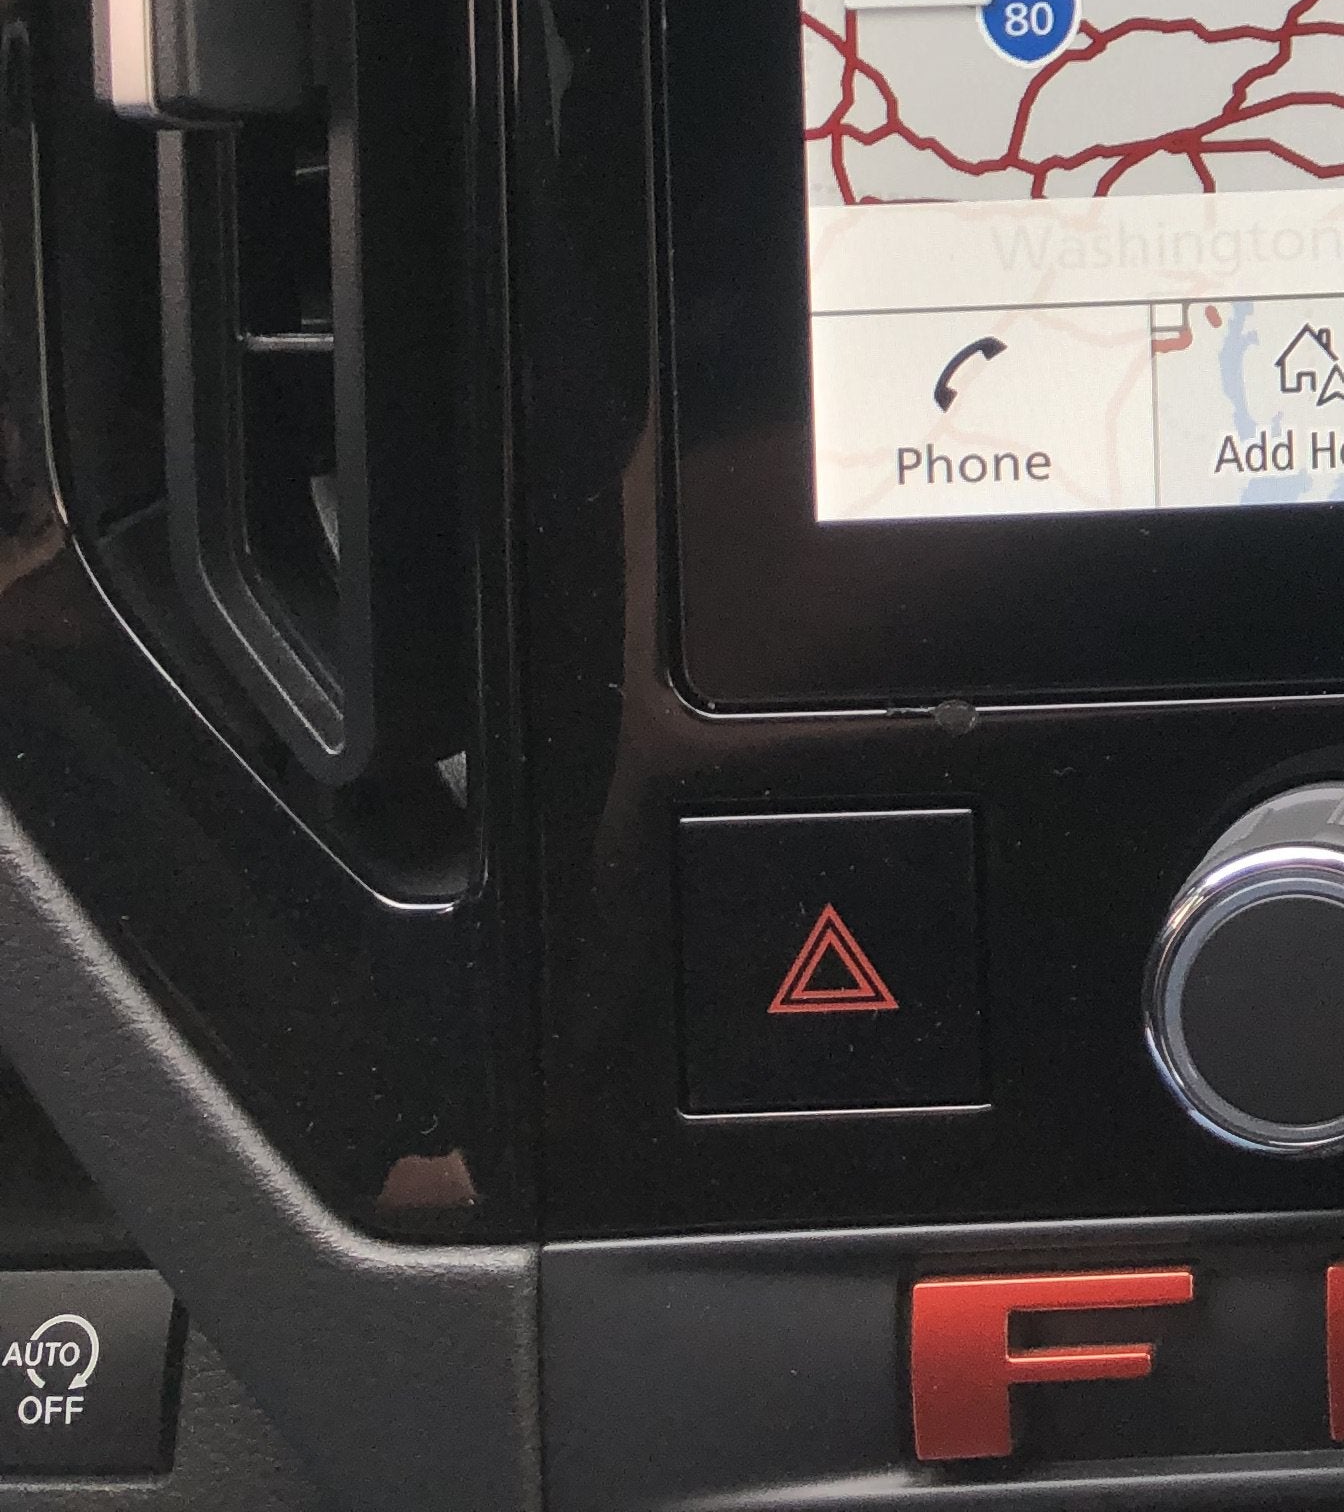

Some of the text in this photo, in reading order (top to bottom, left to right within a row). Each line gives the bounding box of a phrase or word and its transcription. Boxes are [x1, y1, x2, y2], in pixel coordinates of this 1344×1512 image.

[1003, 1, 1055, 37] 80
[990, 218, 1344, 277] Washington
[896, 445, 1052, 485] Phone
[1214, 434, 1295, 474] Add
[1, 1341, 81, 1367] AUTO
[17, 1395, 85, 1425] OFF
